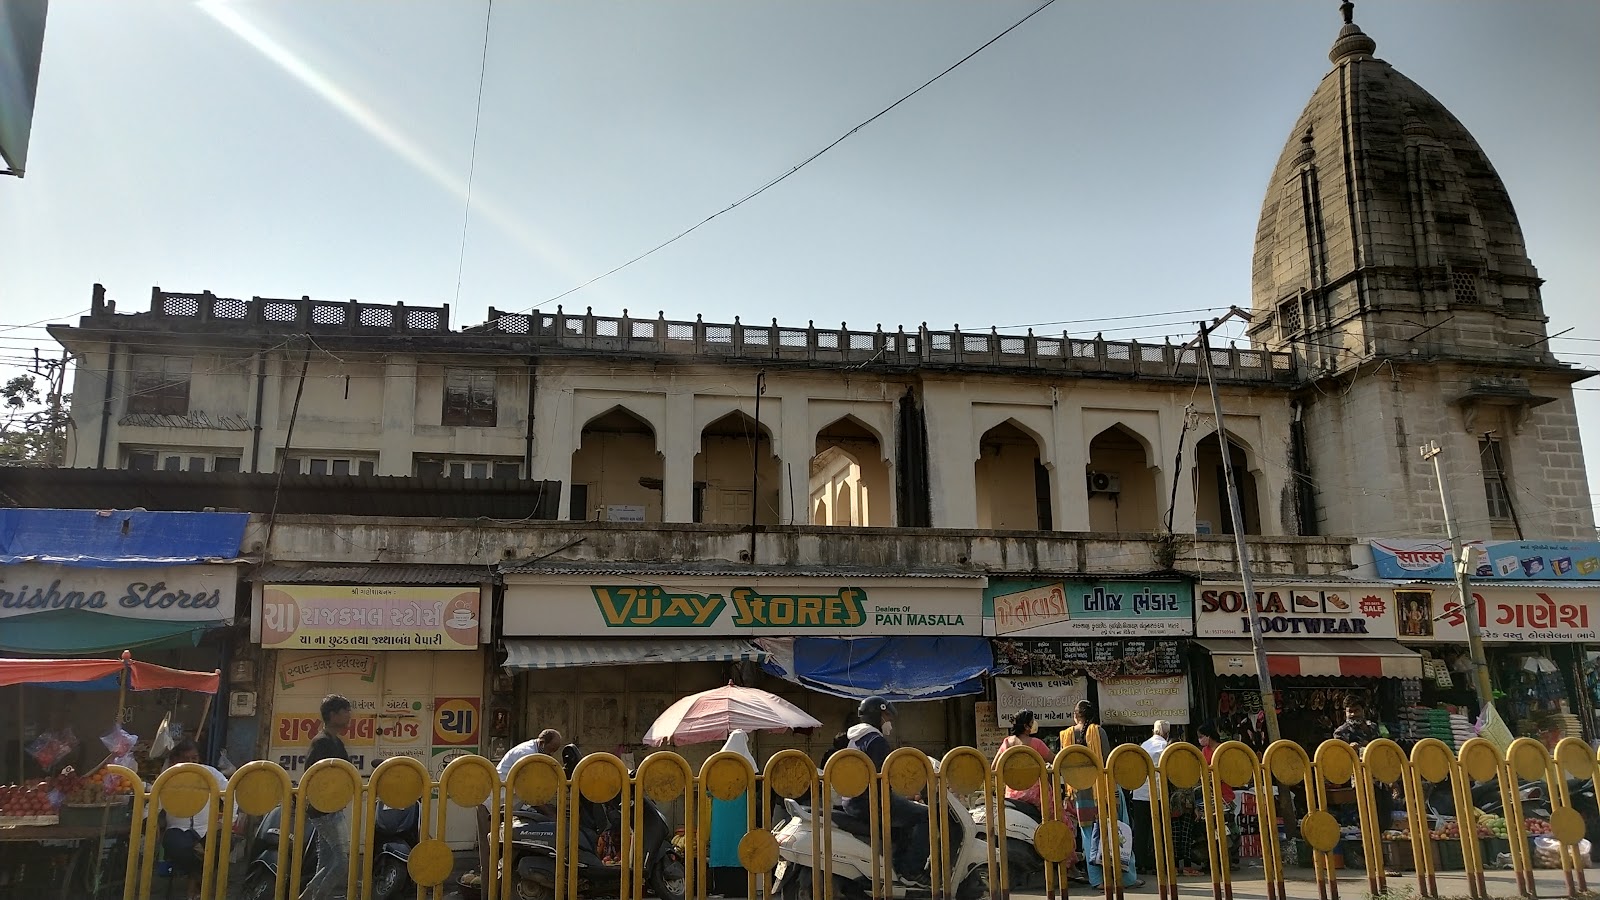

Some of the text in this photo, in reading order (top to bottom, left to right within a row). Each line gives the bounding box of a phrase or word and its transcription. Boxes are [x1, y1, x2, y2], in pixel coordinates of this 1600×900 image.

[1395, 551, 1445, 564] सारस
[118, 581, 220, 609] Stores
[997, 587, 1067, 627] ખેતીવાડી
[1083, 587, 1179, 615] બીજ ભંડાર
[264, 603, 295, 632] ચા
[301, 600, 444, 627] રાજકમલ સ્ટોર્સ
[875, 605, 911, 613] Dealers Of
[875, 614, 965, 626] PAN MASALA
[1496, 593, 1589, 628] ગણેશ
[300, 635, 313, 645] ચા
[314, 635, 326, 645] ના
[350, 635, 369, 645] તથા
[414, 633, 442, 645] વેપારી
[1503, 631, 1523, 640] વસ્તુ
[1528, 630, 1573, 639] હોલસેલના
[1577, 630, 1596, 639] ભાવે
[280, 718, 374, 741] રાજમલ
[440, 710, 473, 734] ચા
